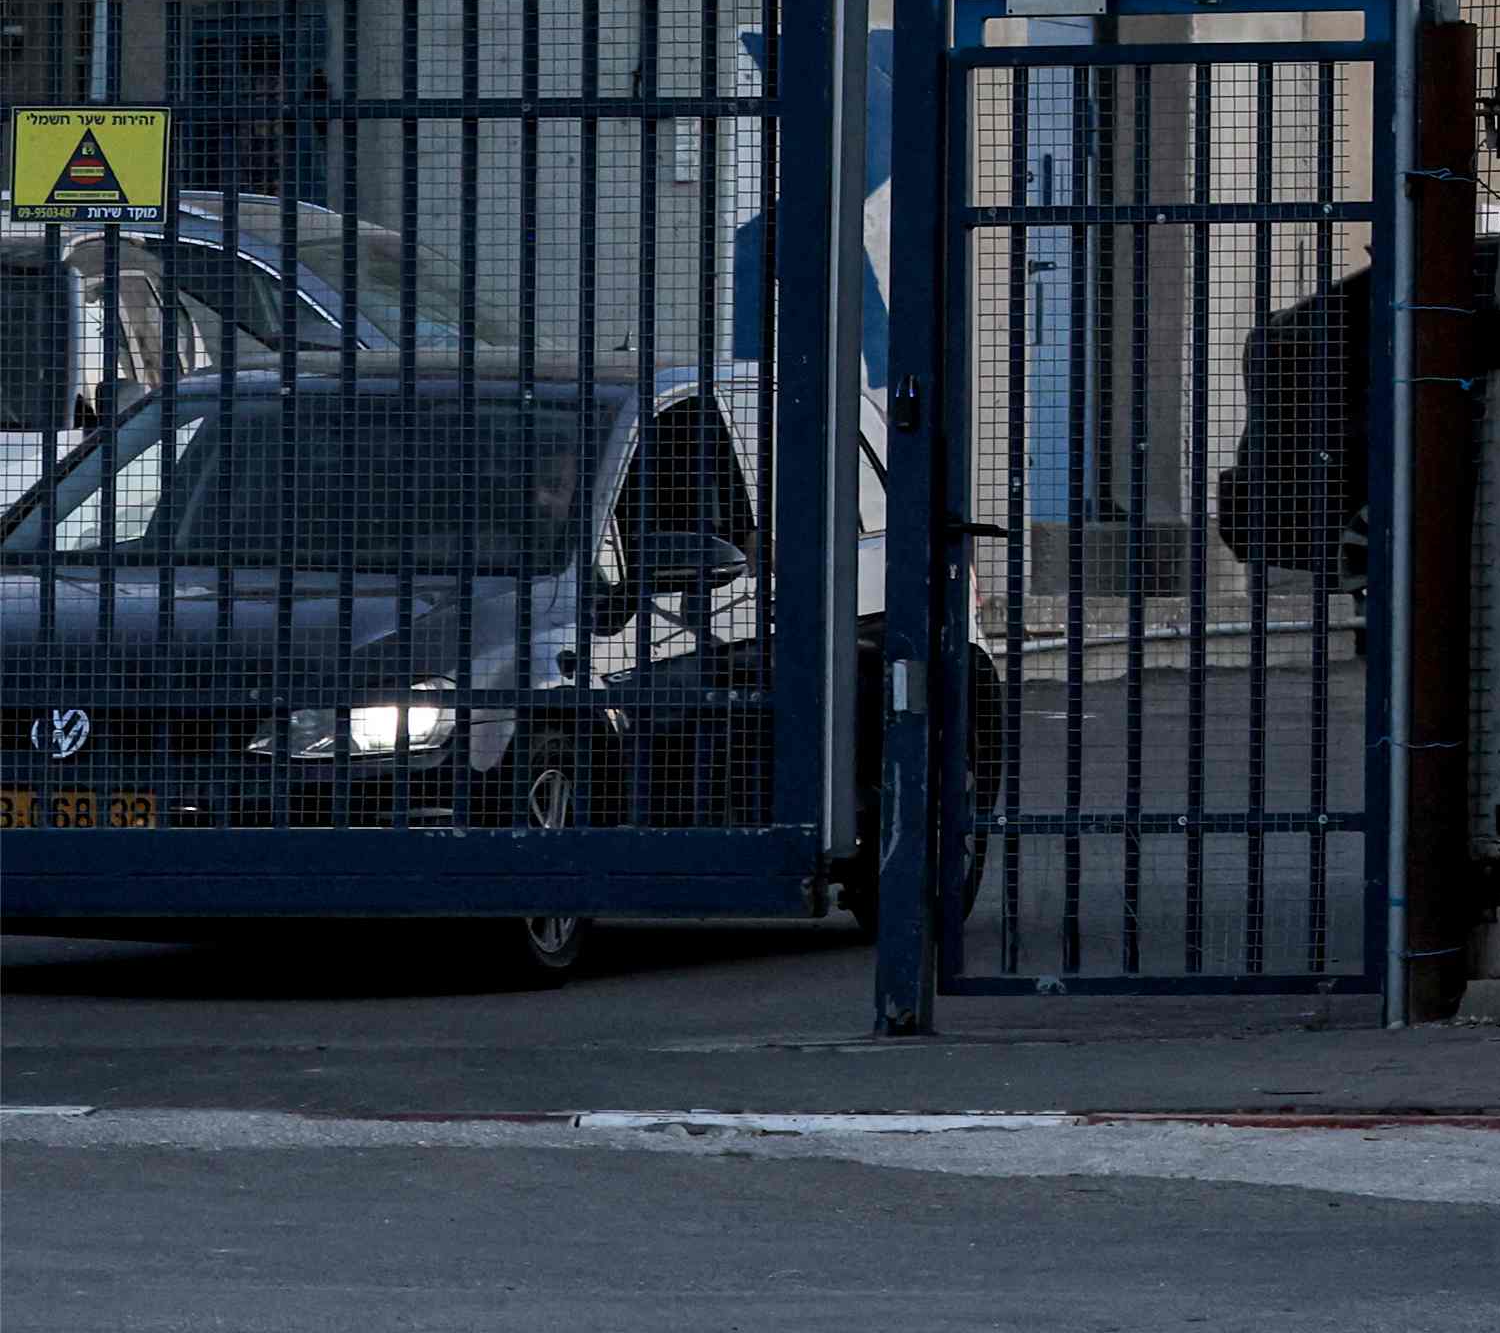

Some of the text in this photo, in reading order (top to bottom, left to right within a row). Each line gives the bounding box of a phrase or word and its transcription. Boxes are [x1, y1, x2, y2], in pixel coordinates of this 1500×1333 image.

[26, 112, 156, 126] זהירות שער חשמלי
[87, 207, 122, 219] שירות
[127, 207, 158, 221] מוקד
